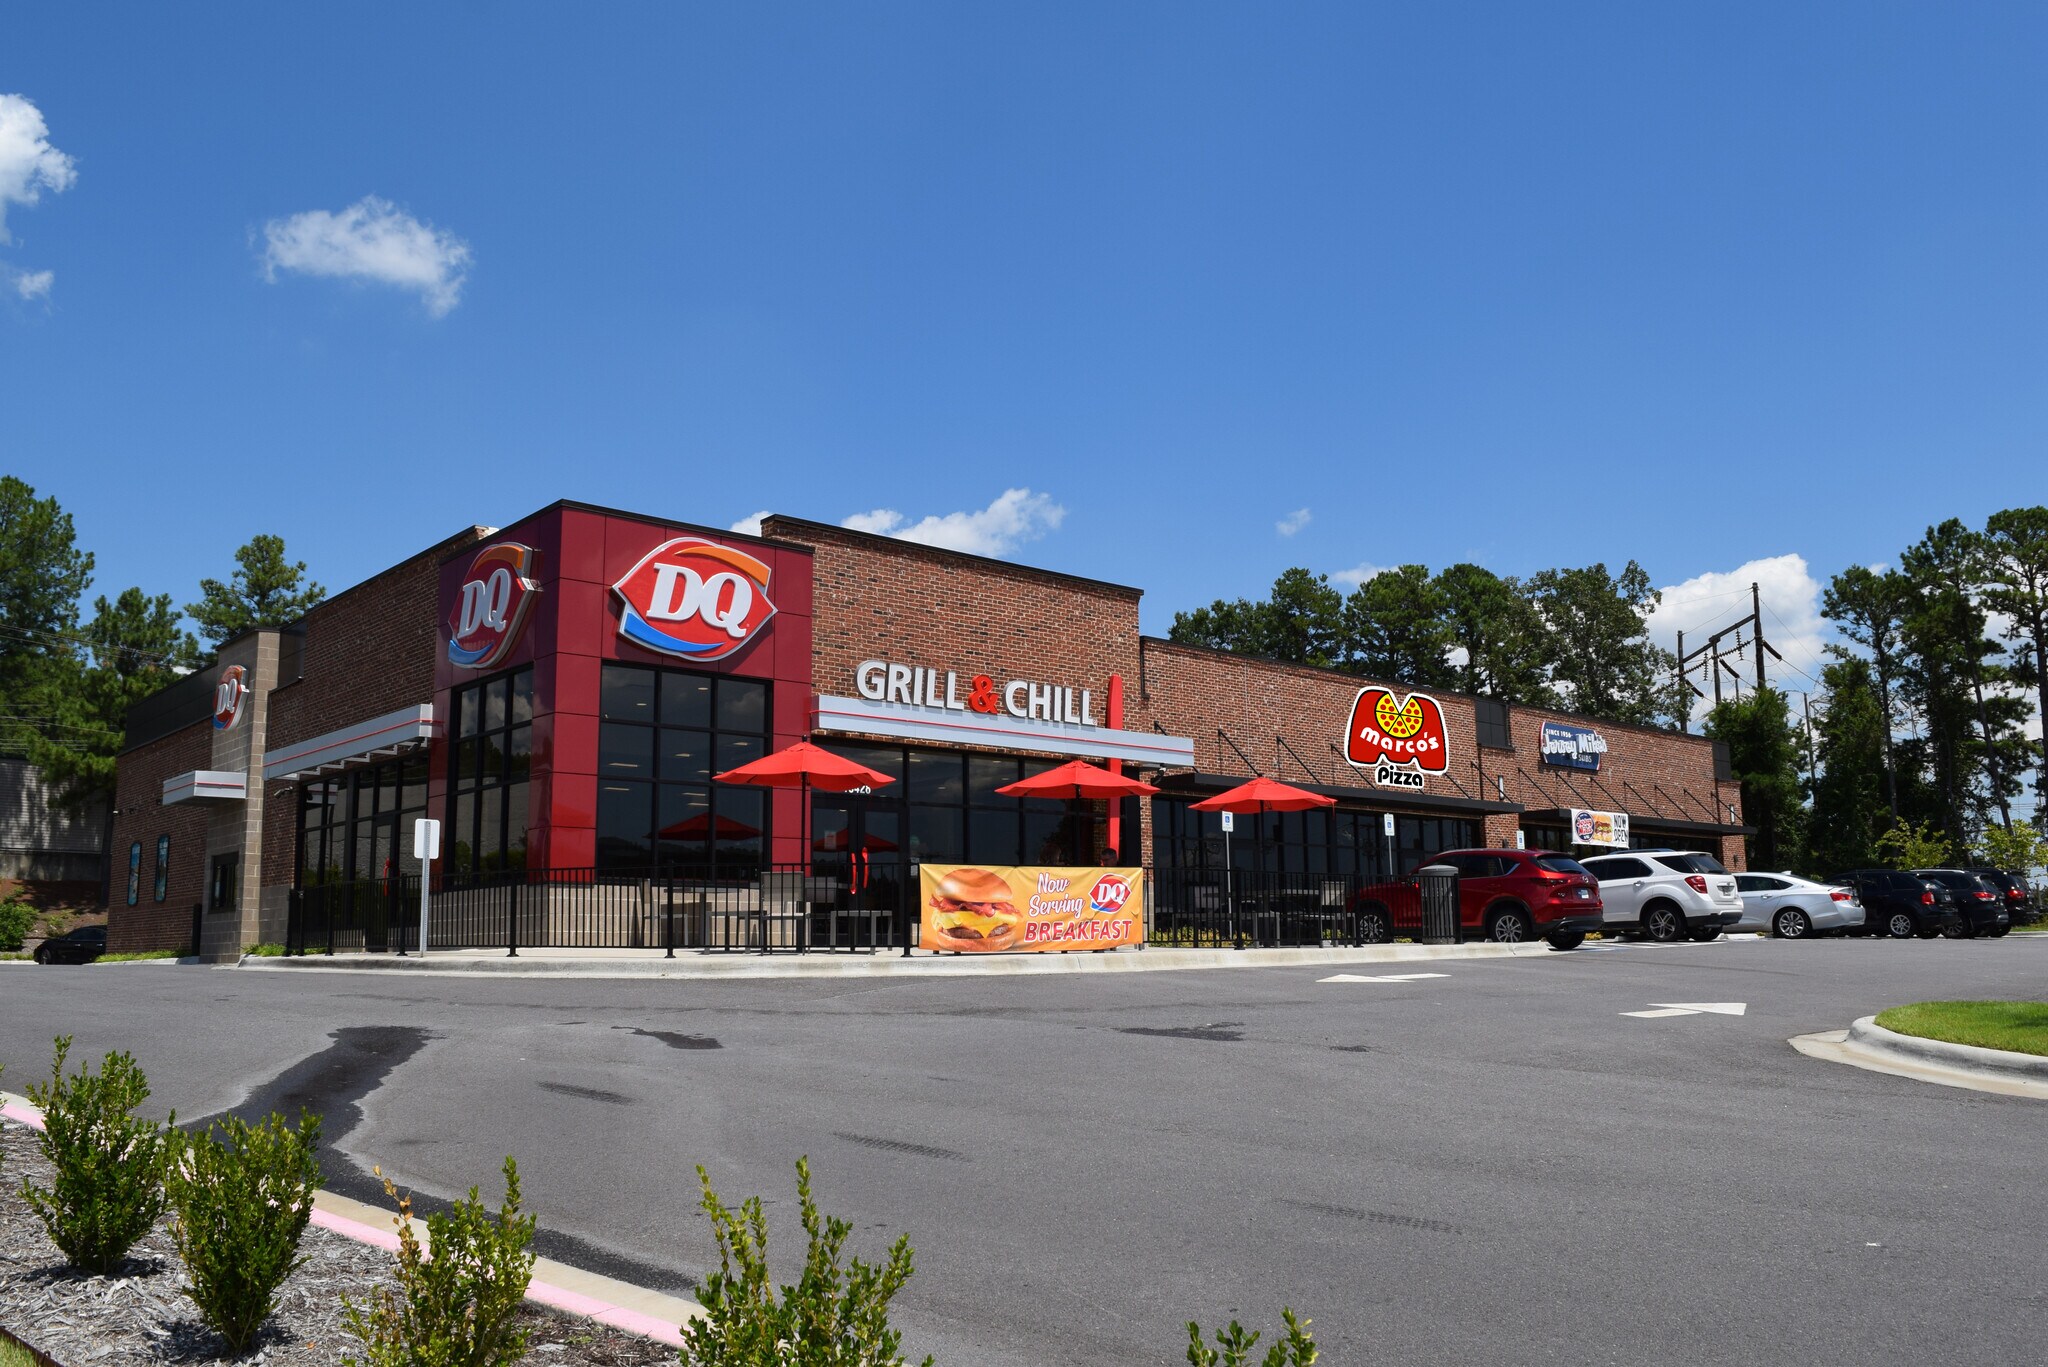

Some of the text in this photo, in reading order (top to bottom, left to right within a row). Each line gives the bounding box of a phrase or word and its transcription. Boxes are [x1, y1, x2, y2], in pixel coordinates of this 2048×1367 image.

[456, 568, 512, 639] DQ
[646, 562, 753, 638] DQ
[216, 678, 237, 716] DQ
[856, 660, 1095, 727] GRILL & CHILL
[1578, 754, 1592, 763] SUBS
[1613, 814, 1627, 829] NOW
[1613, 828, 1628, 842] OPEN
[1037, 873, 1070, 894] Now
[1097, 883, 1127, 904] DQ
[1028, 894, 1085, 918] Serving
[1024, 919, 1133, 942] BREAKFAST
